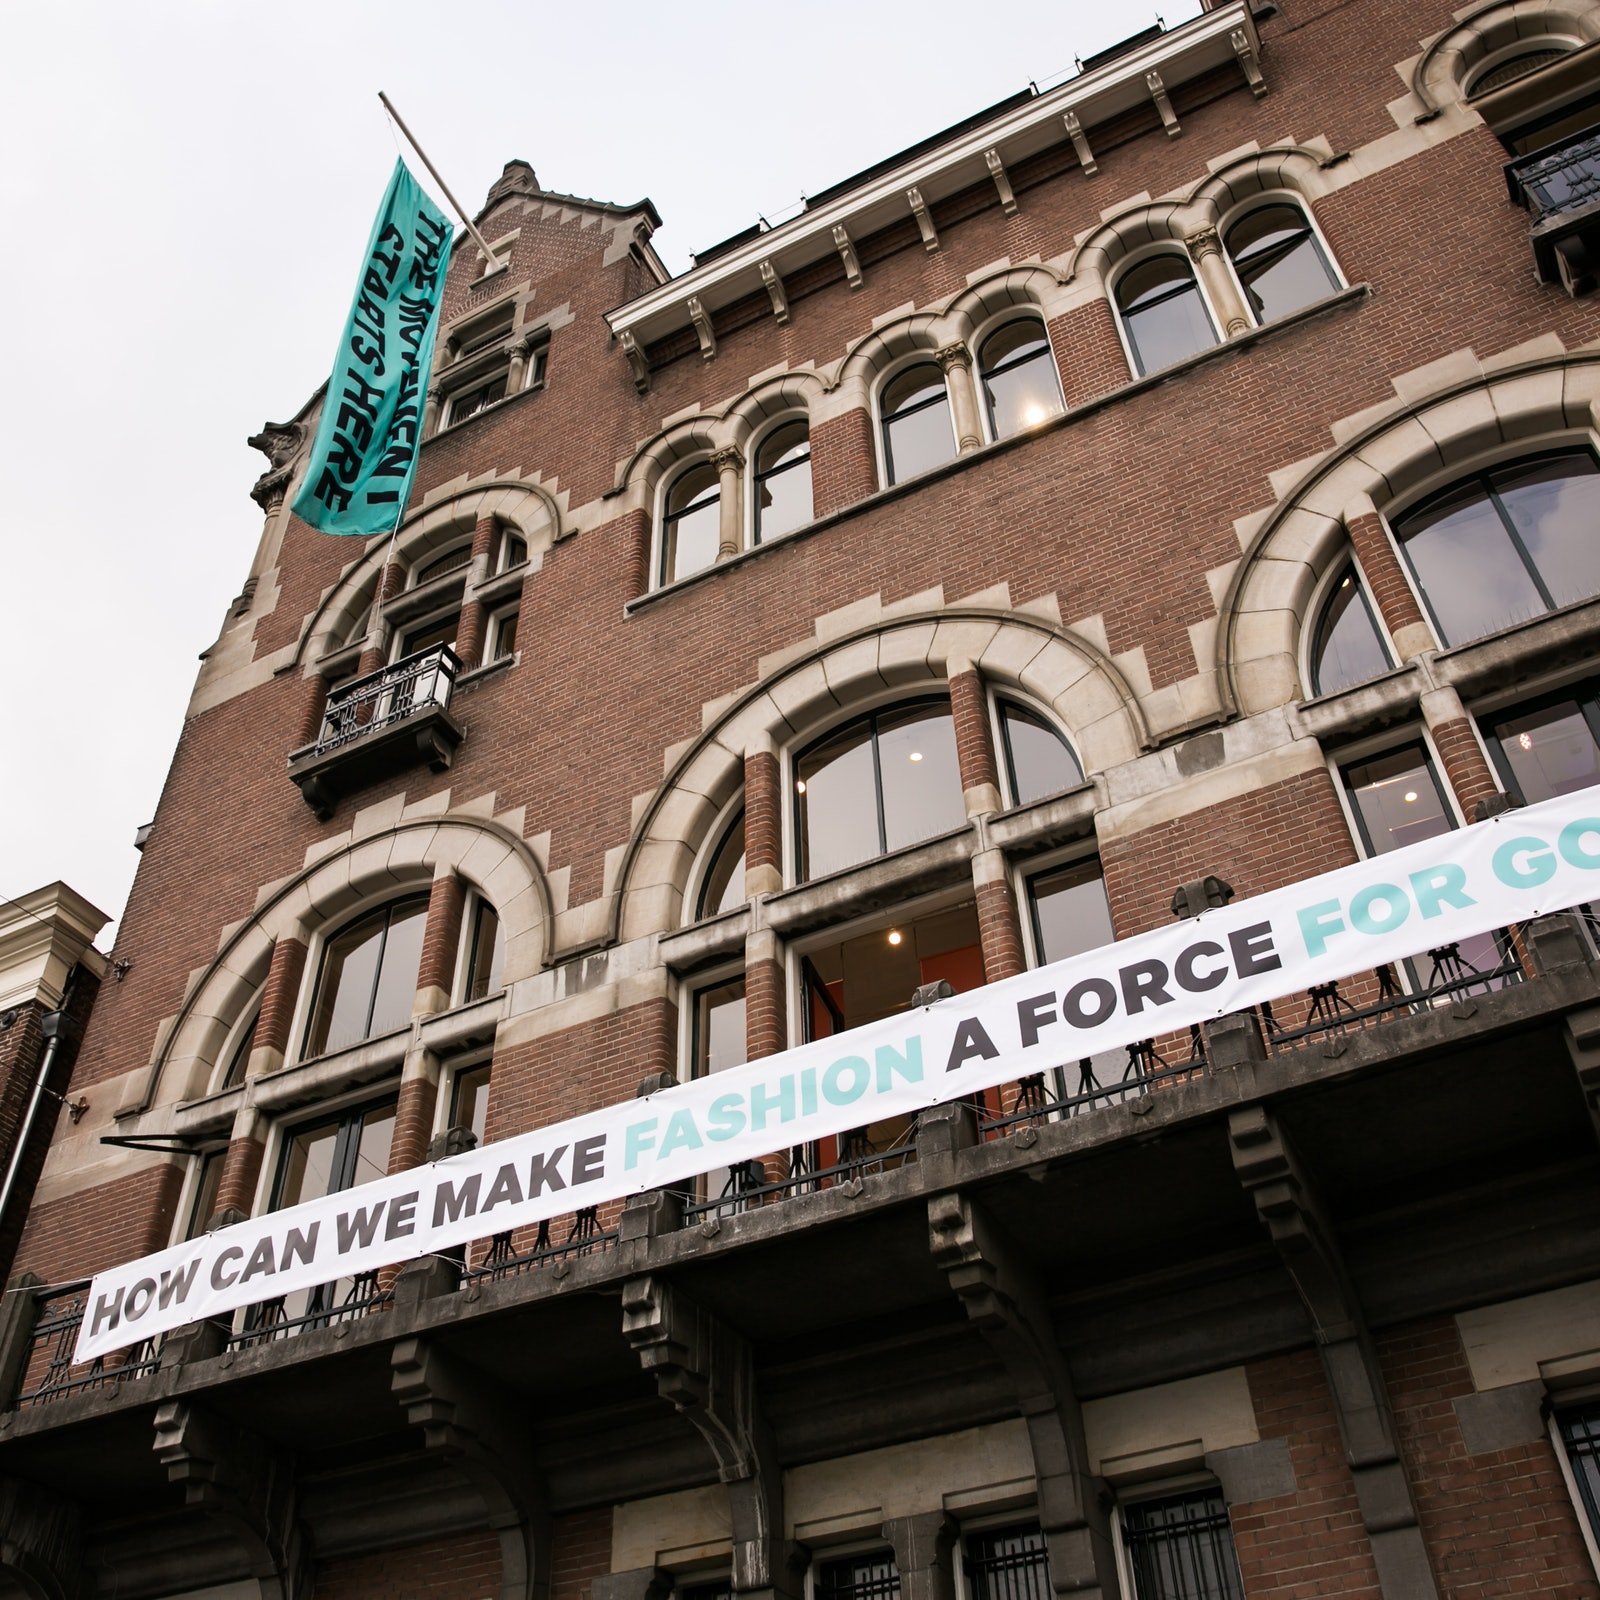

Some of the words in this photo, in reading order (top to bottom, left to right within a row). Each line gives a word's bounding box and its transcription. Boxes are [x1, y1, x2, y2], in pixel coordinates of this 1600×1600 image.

[350, 222, 405, 377] STARTS
[409, 209, 447, 293] THE
[313, 366, 386, 514] HERE
[89, 1258, 202, 1338] HOW
[210, 1220, 321, 1291] CAN
[336, 1190, 420, 1255] WE
[431, 1133, 607, 1229] MAKE
[623, 1035, 924, 1172] FASHION
[945, 1016, 1001, 1073] A
[1016, 920, 1283, 1049] FORCE
[1296, 863, 1479, 959] FOR
